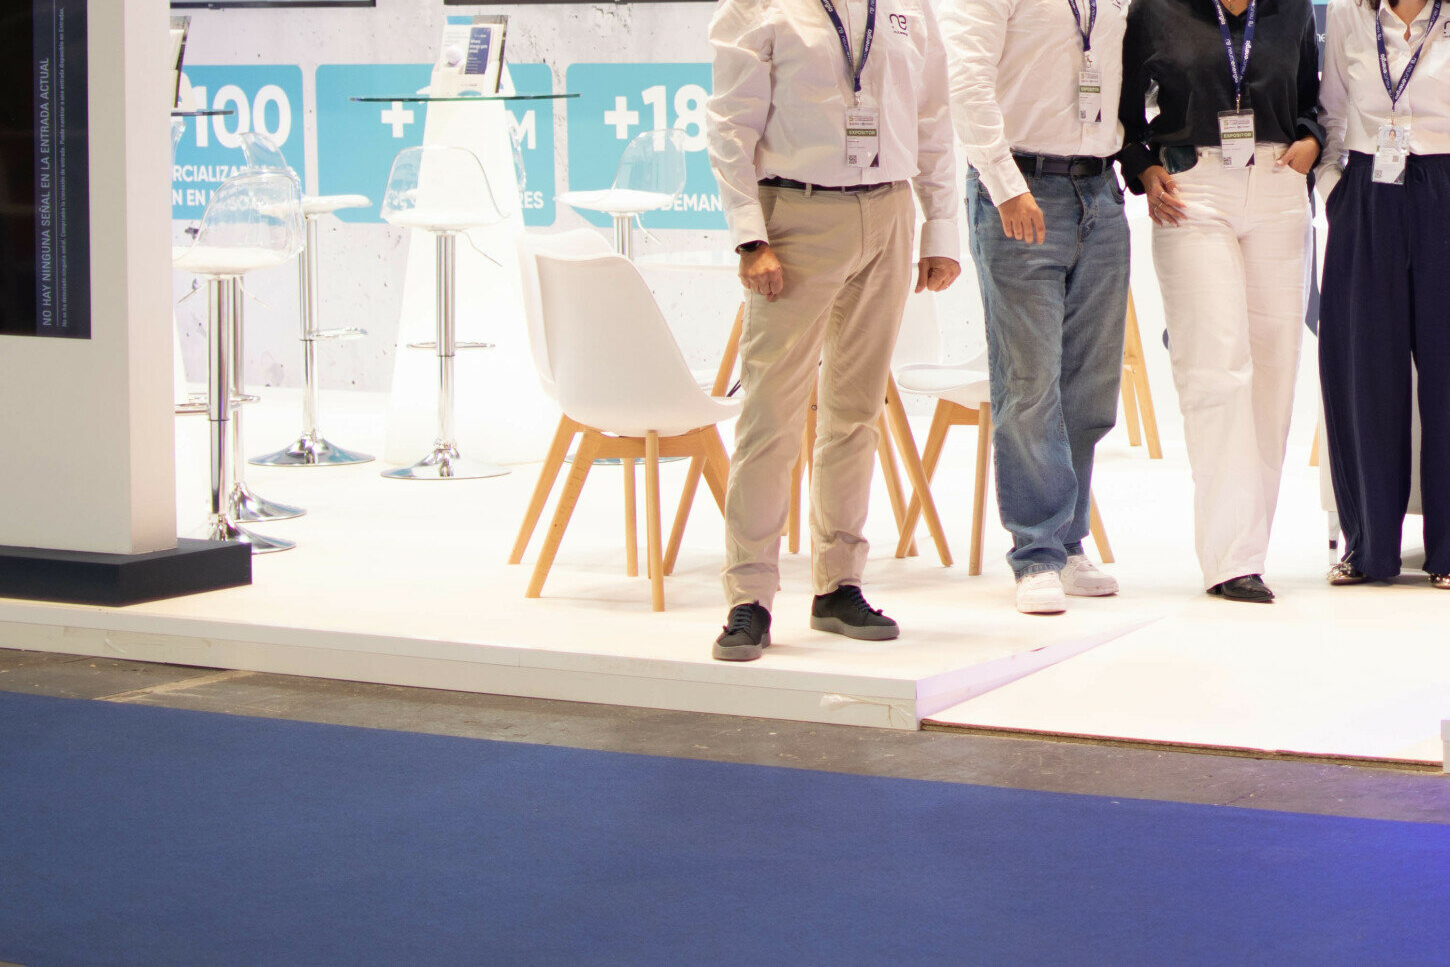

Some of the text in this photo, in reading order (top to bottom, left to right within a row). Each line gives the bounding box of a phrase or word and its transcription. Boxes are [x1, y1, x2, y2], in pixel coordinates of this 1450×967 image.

[38, 57, 52, 326] NO HAY NINGUNA SEÑAL EN LA ENTRADA ACTUAL
